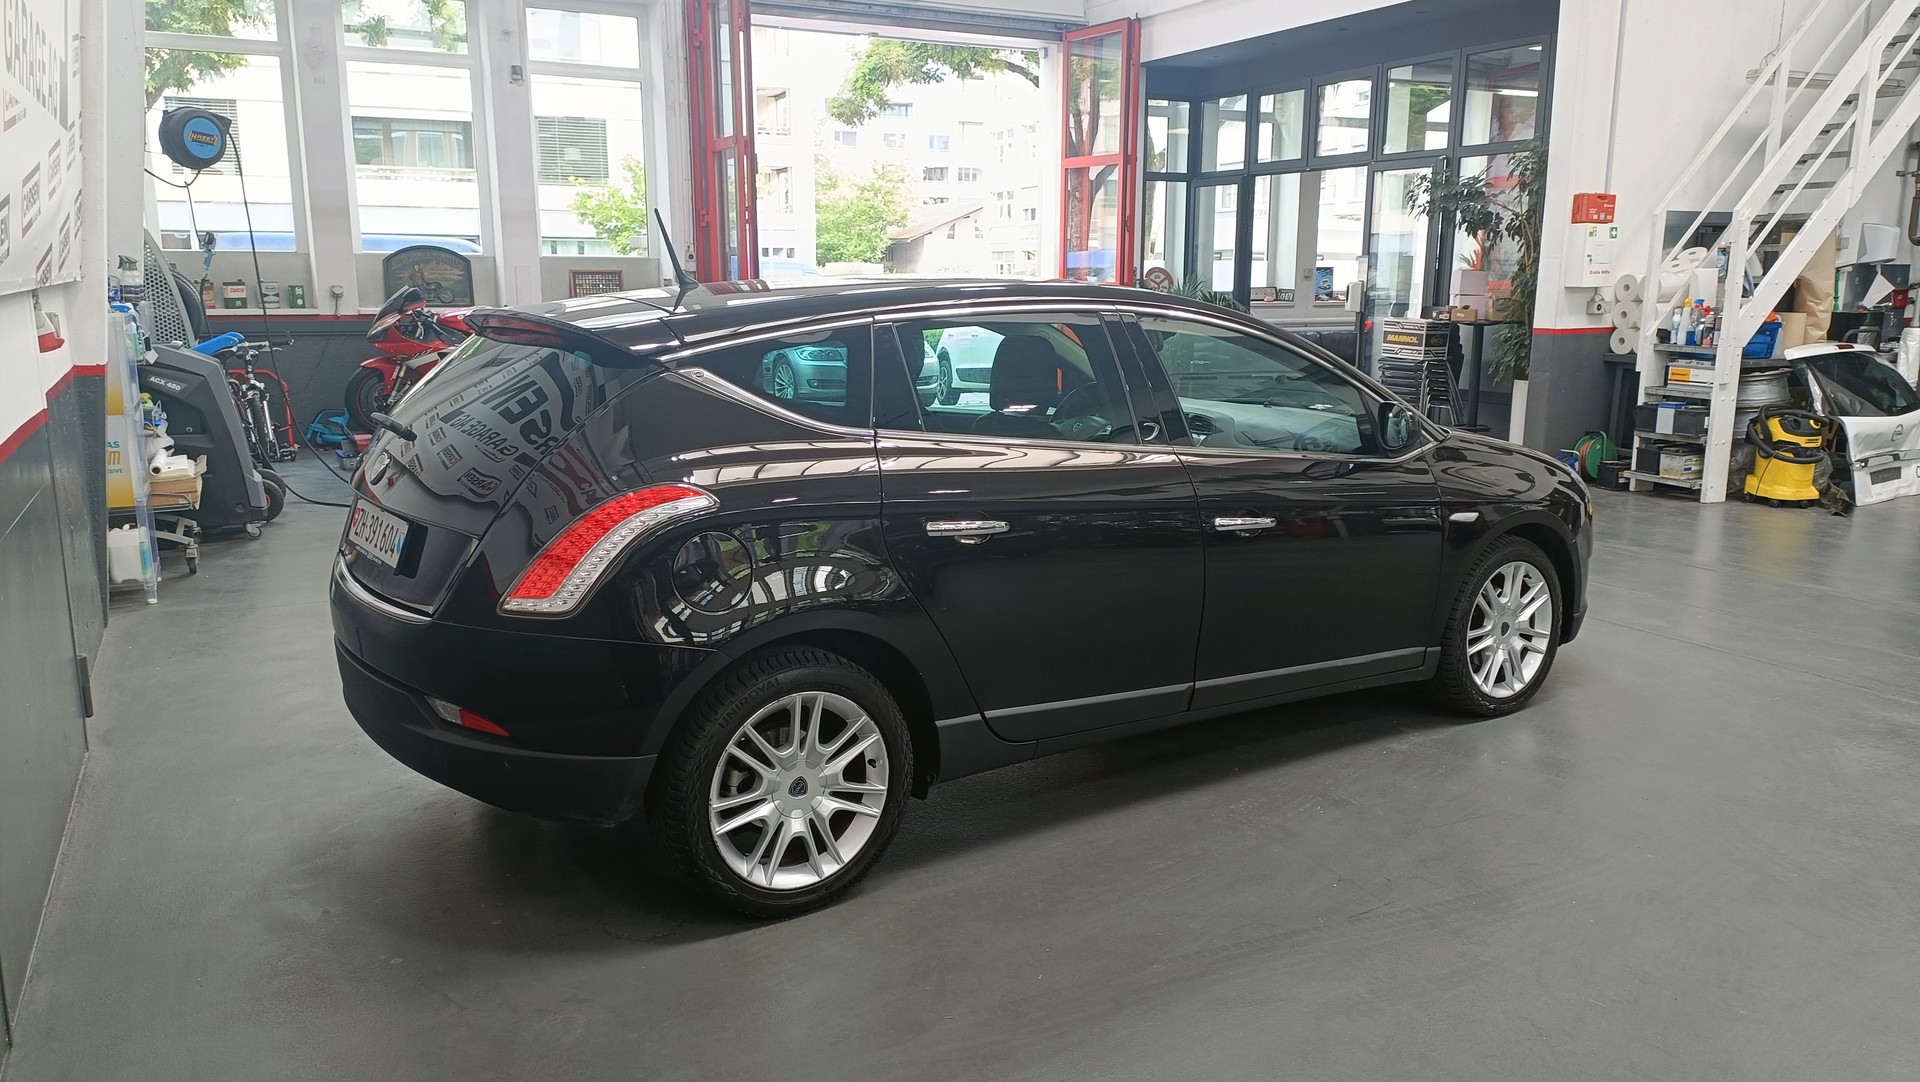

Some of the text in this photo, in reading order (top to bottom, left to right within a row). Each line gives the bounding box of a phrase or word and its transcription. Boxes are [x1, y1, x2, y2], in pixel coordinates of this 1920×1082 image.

[4, 0, 58, 121] GARAGE AG
[191, 132, 215, 143] HAZET
[1386, 333, 1419, 344] MANNOL
[149, 376, 182, 392] ACX 450
[717, 677, 784, 730] UNIROYAL
